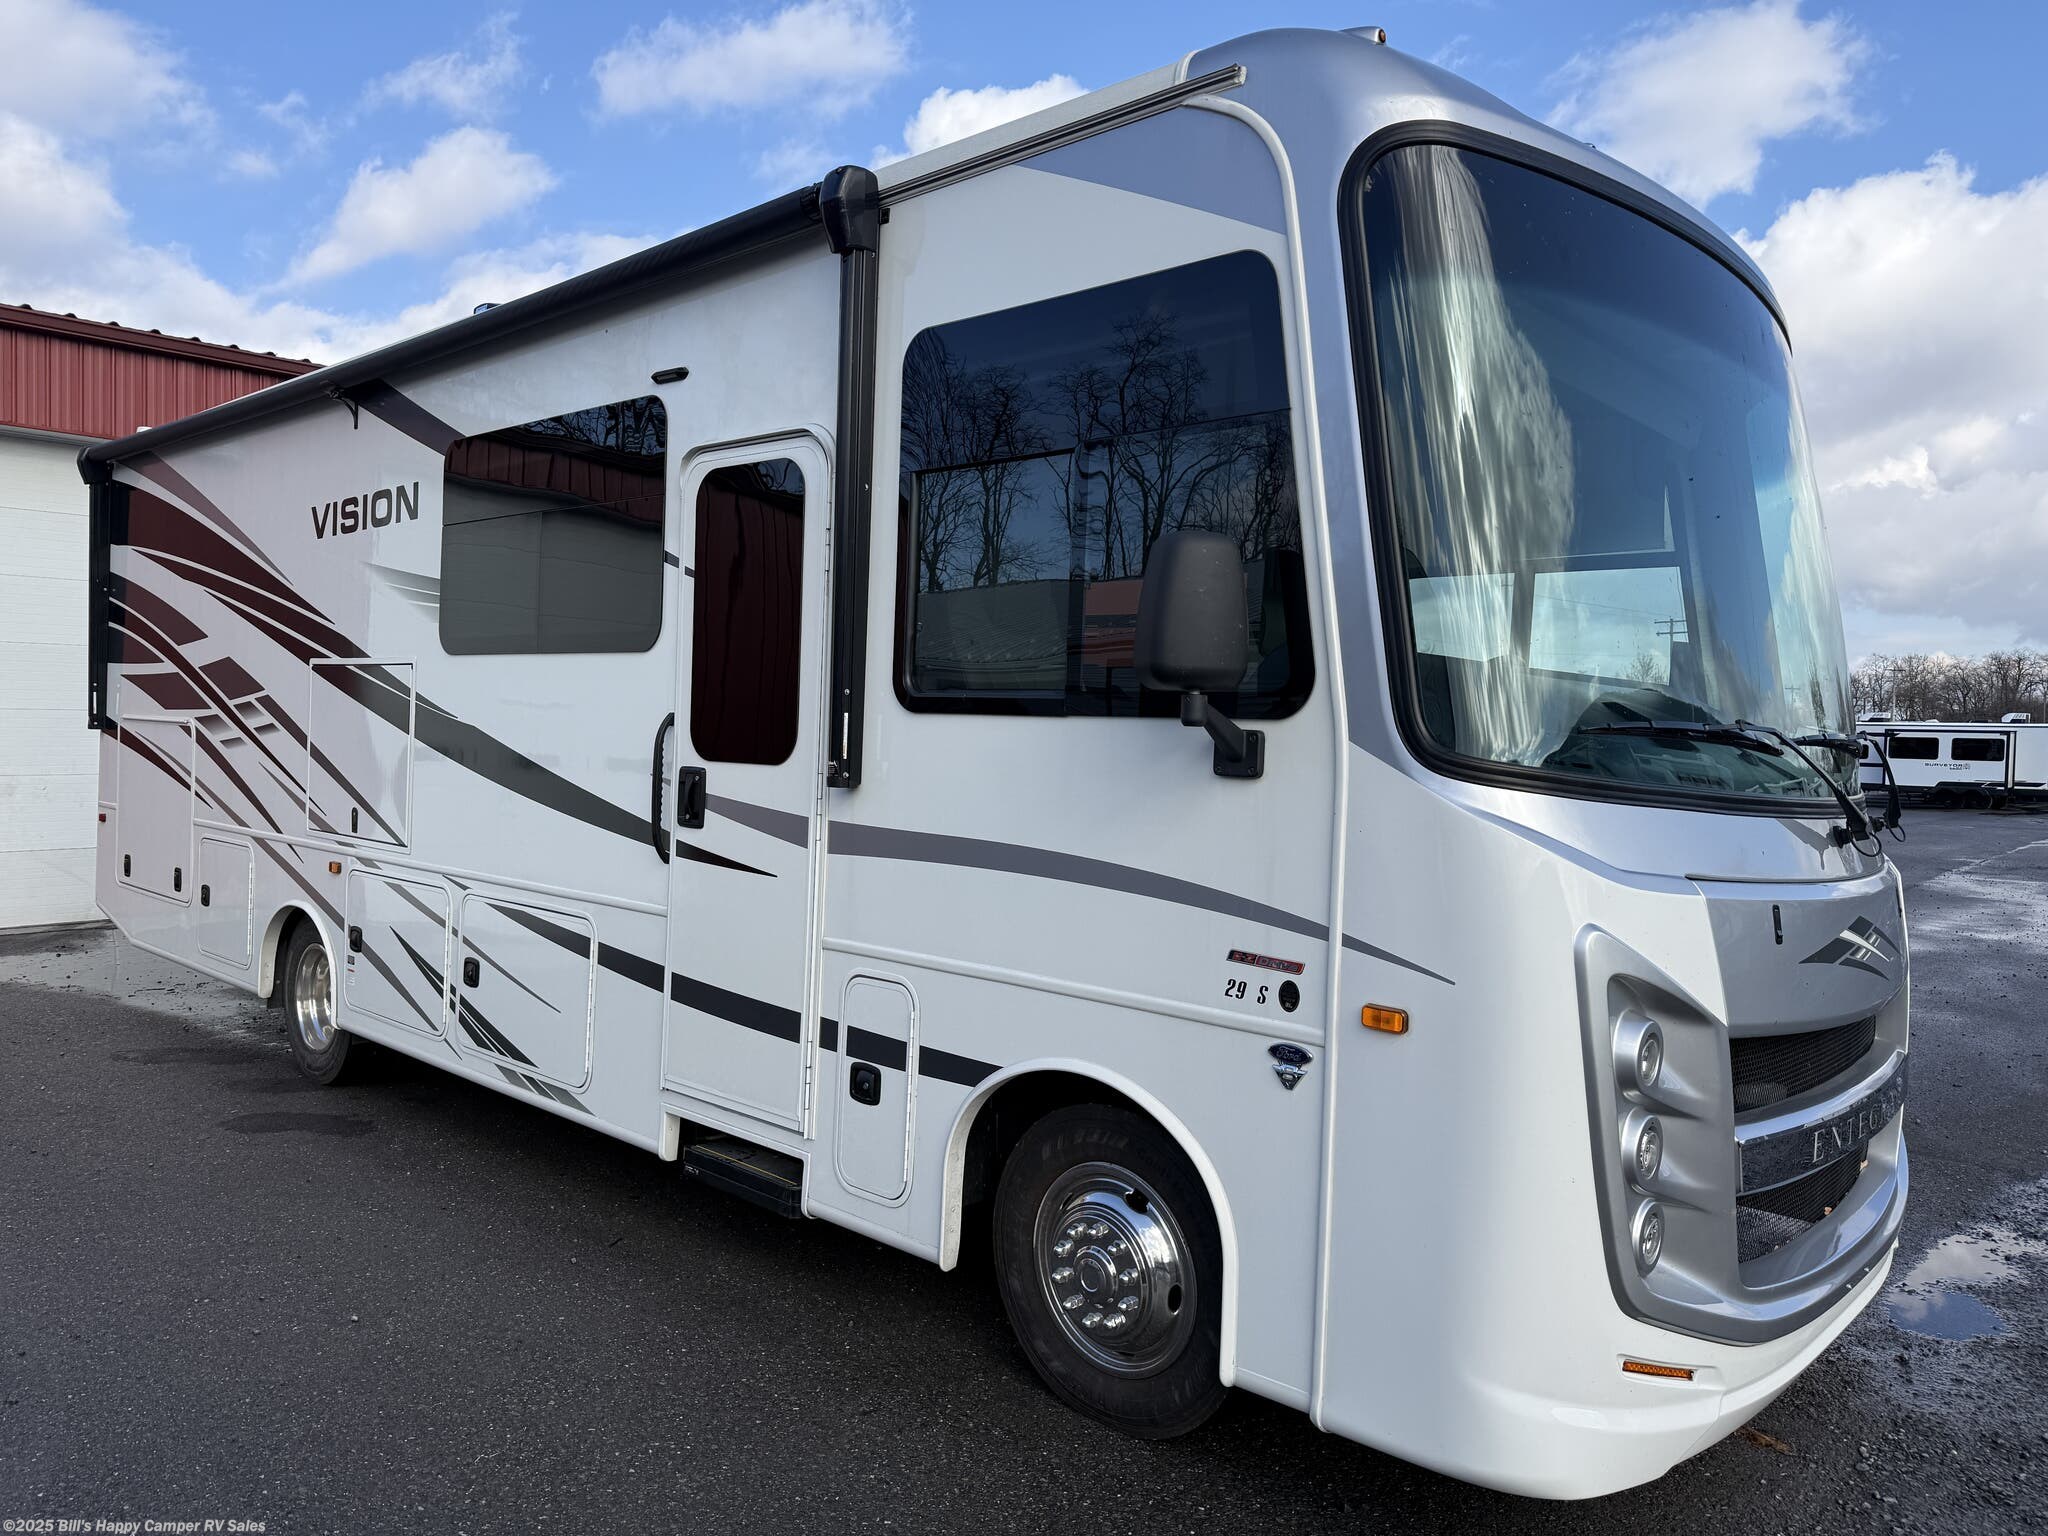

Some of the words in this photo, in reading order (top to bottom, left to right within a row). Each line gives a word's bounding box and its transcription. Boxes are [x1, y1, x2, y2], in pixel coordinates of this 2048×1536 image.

[311, 481, 419, 540] VISION
[1224, 978, 1247, 1000] 29
[1256, 985, 1269, 1005] S
